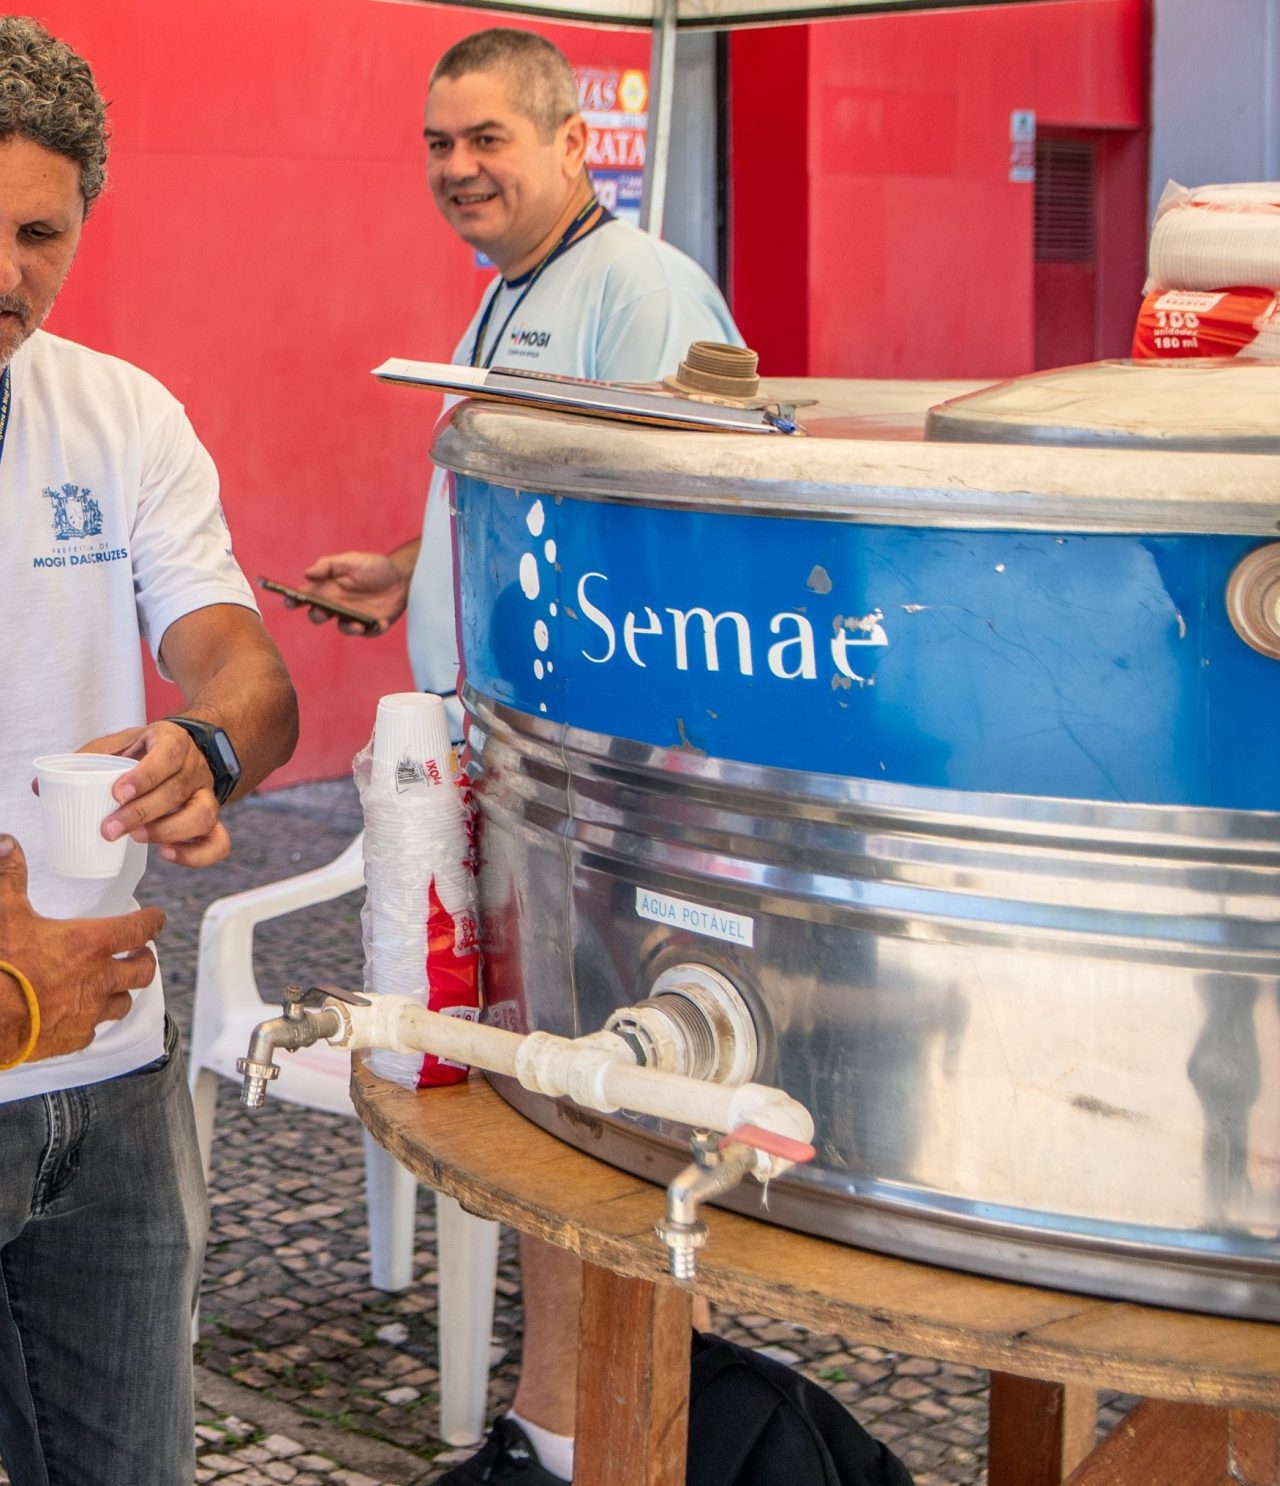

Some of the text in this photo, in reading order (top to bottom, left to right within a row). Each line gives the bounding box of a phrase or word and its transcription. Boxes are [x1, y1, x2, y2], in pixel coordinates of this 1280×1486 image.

[586, 128, 646, 167] RATA
[519, 330, 552, 348] MOGI
[1154, 336, 1180, 349] 180
[33, 556, 66, 568] MOGI
[577, 572, 889, 682] Semae
[682, 907, 745, 939] POTÁVEL
